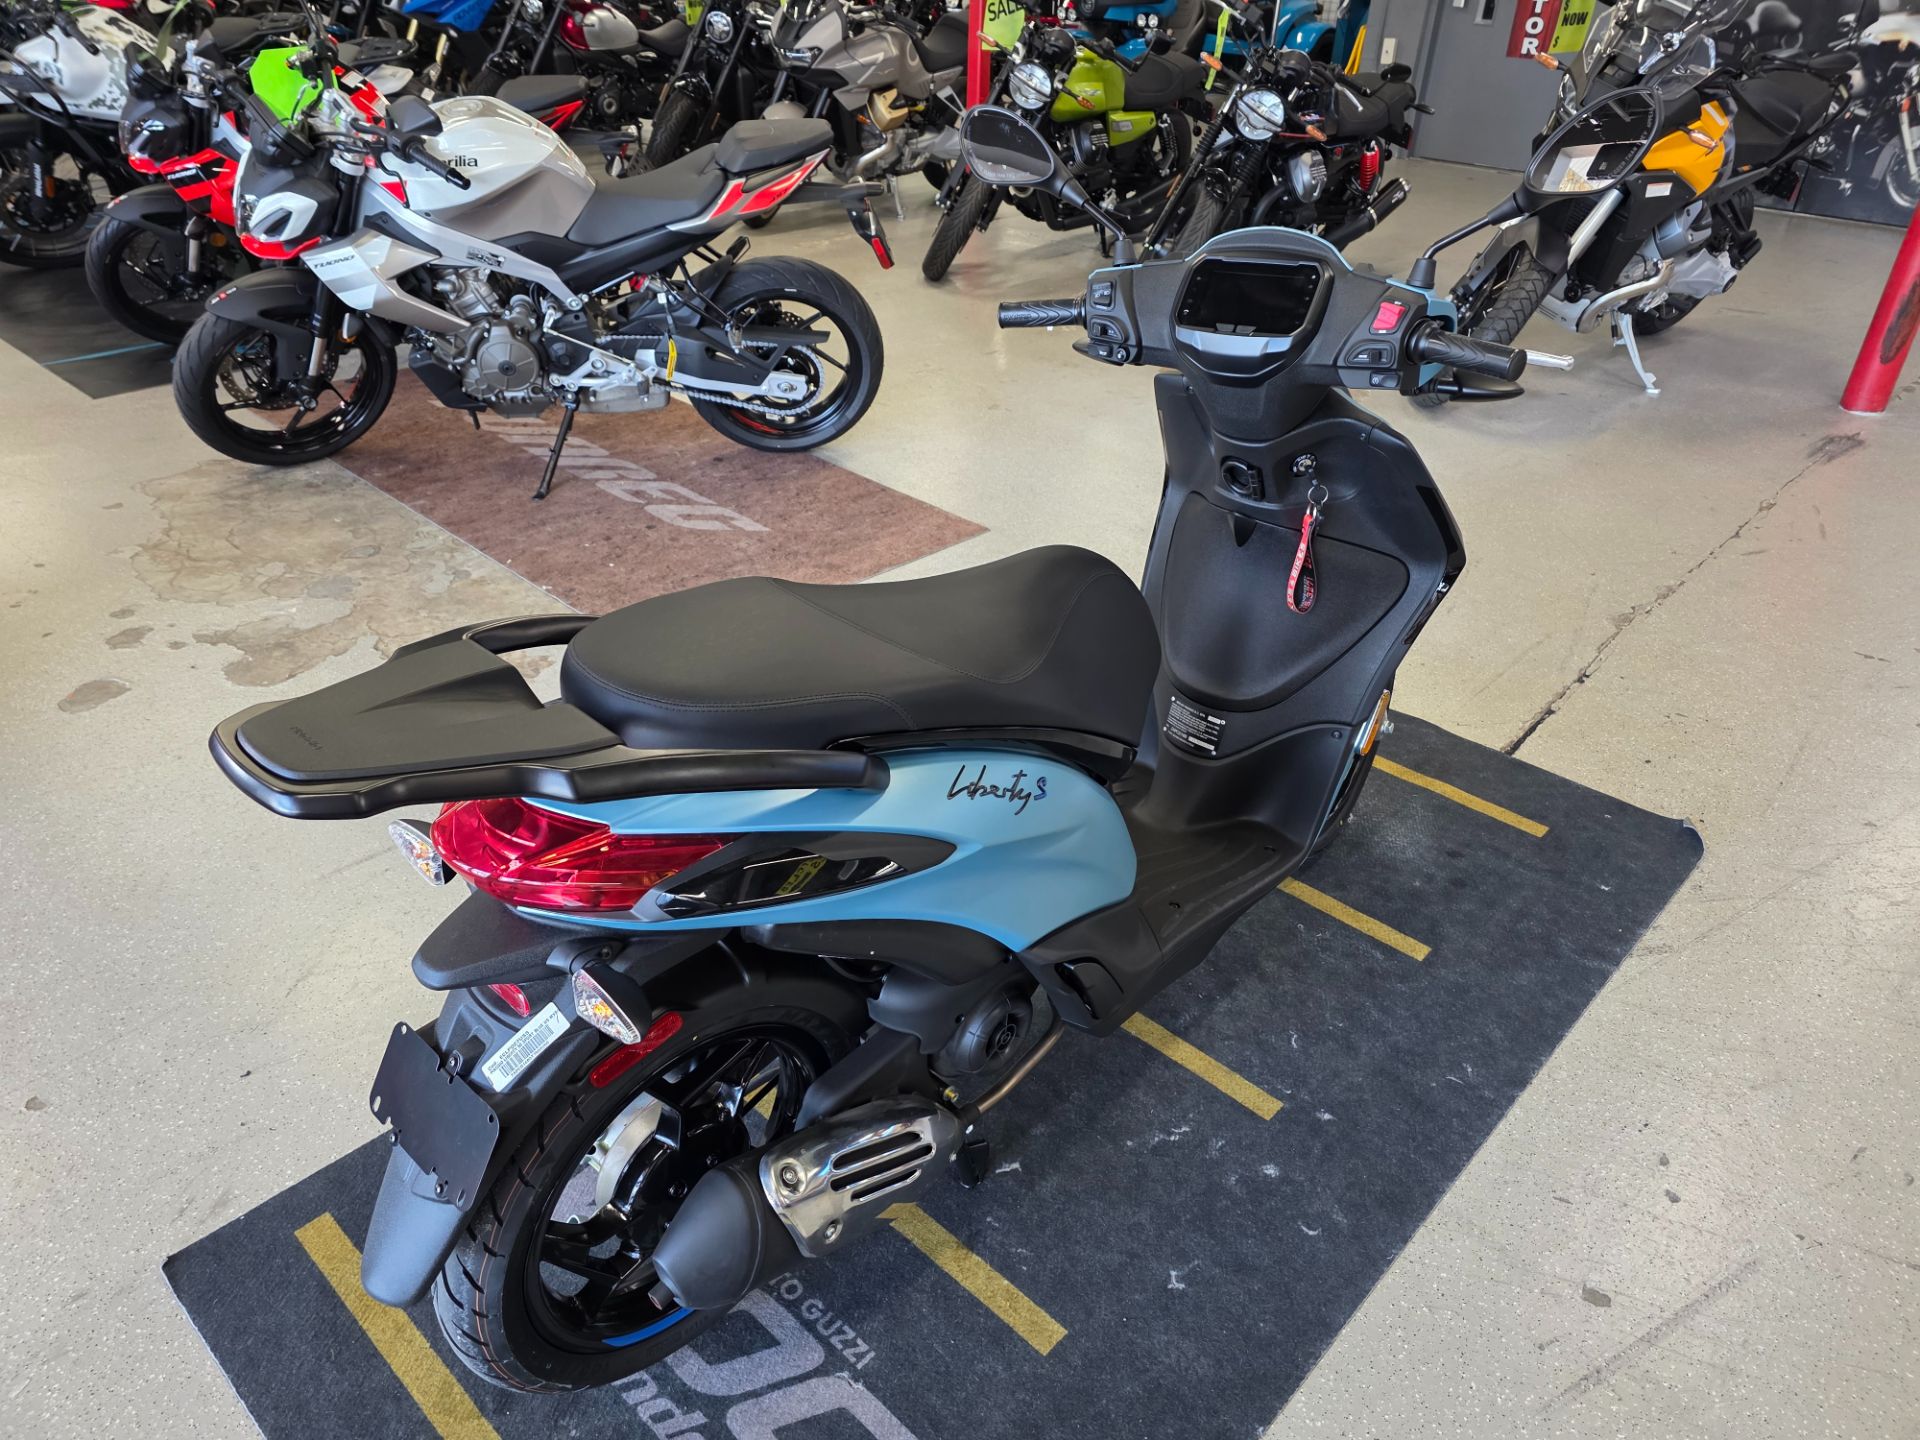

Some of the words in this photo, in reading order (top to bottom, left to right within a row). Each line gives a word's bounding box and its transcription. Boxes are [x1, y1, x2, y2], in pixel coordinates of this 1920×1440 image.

[1561, 12, 1588, 26] NOW
[946, 764, 1032, 816] Liberty
[801, 1298, 877, 1371] GUZZI
